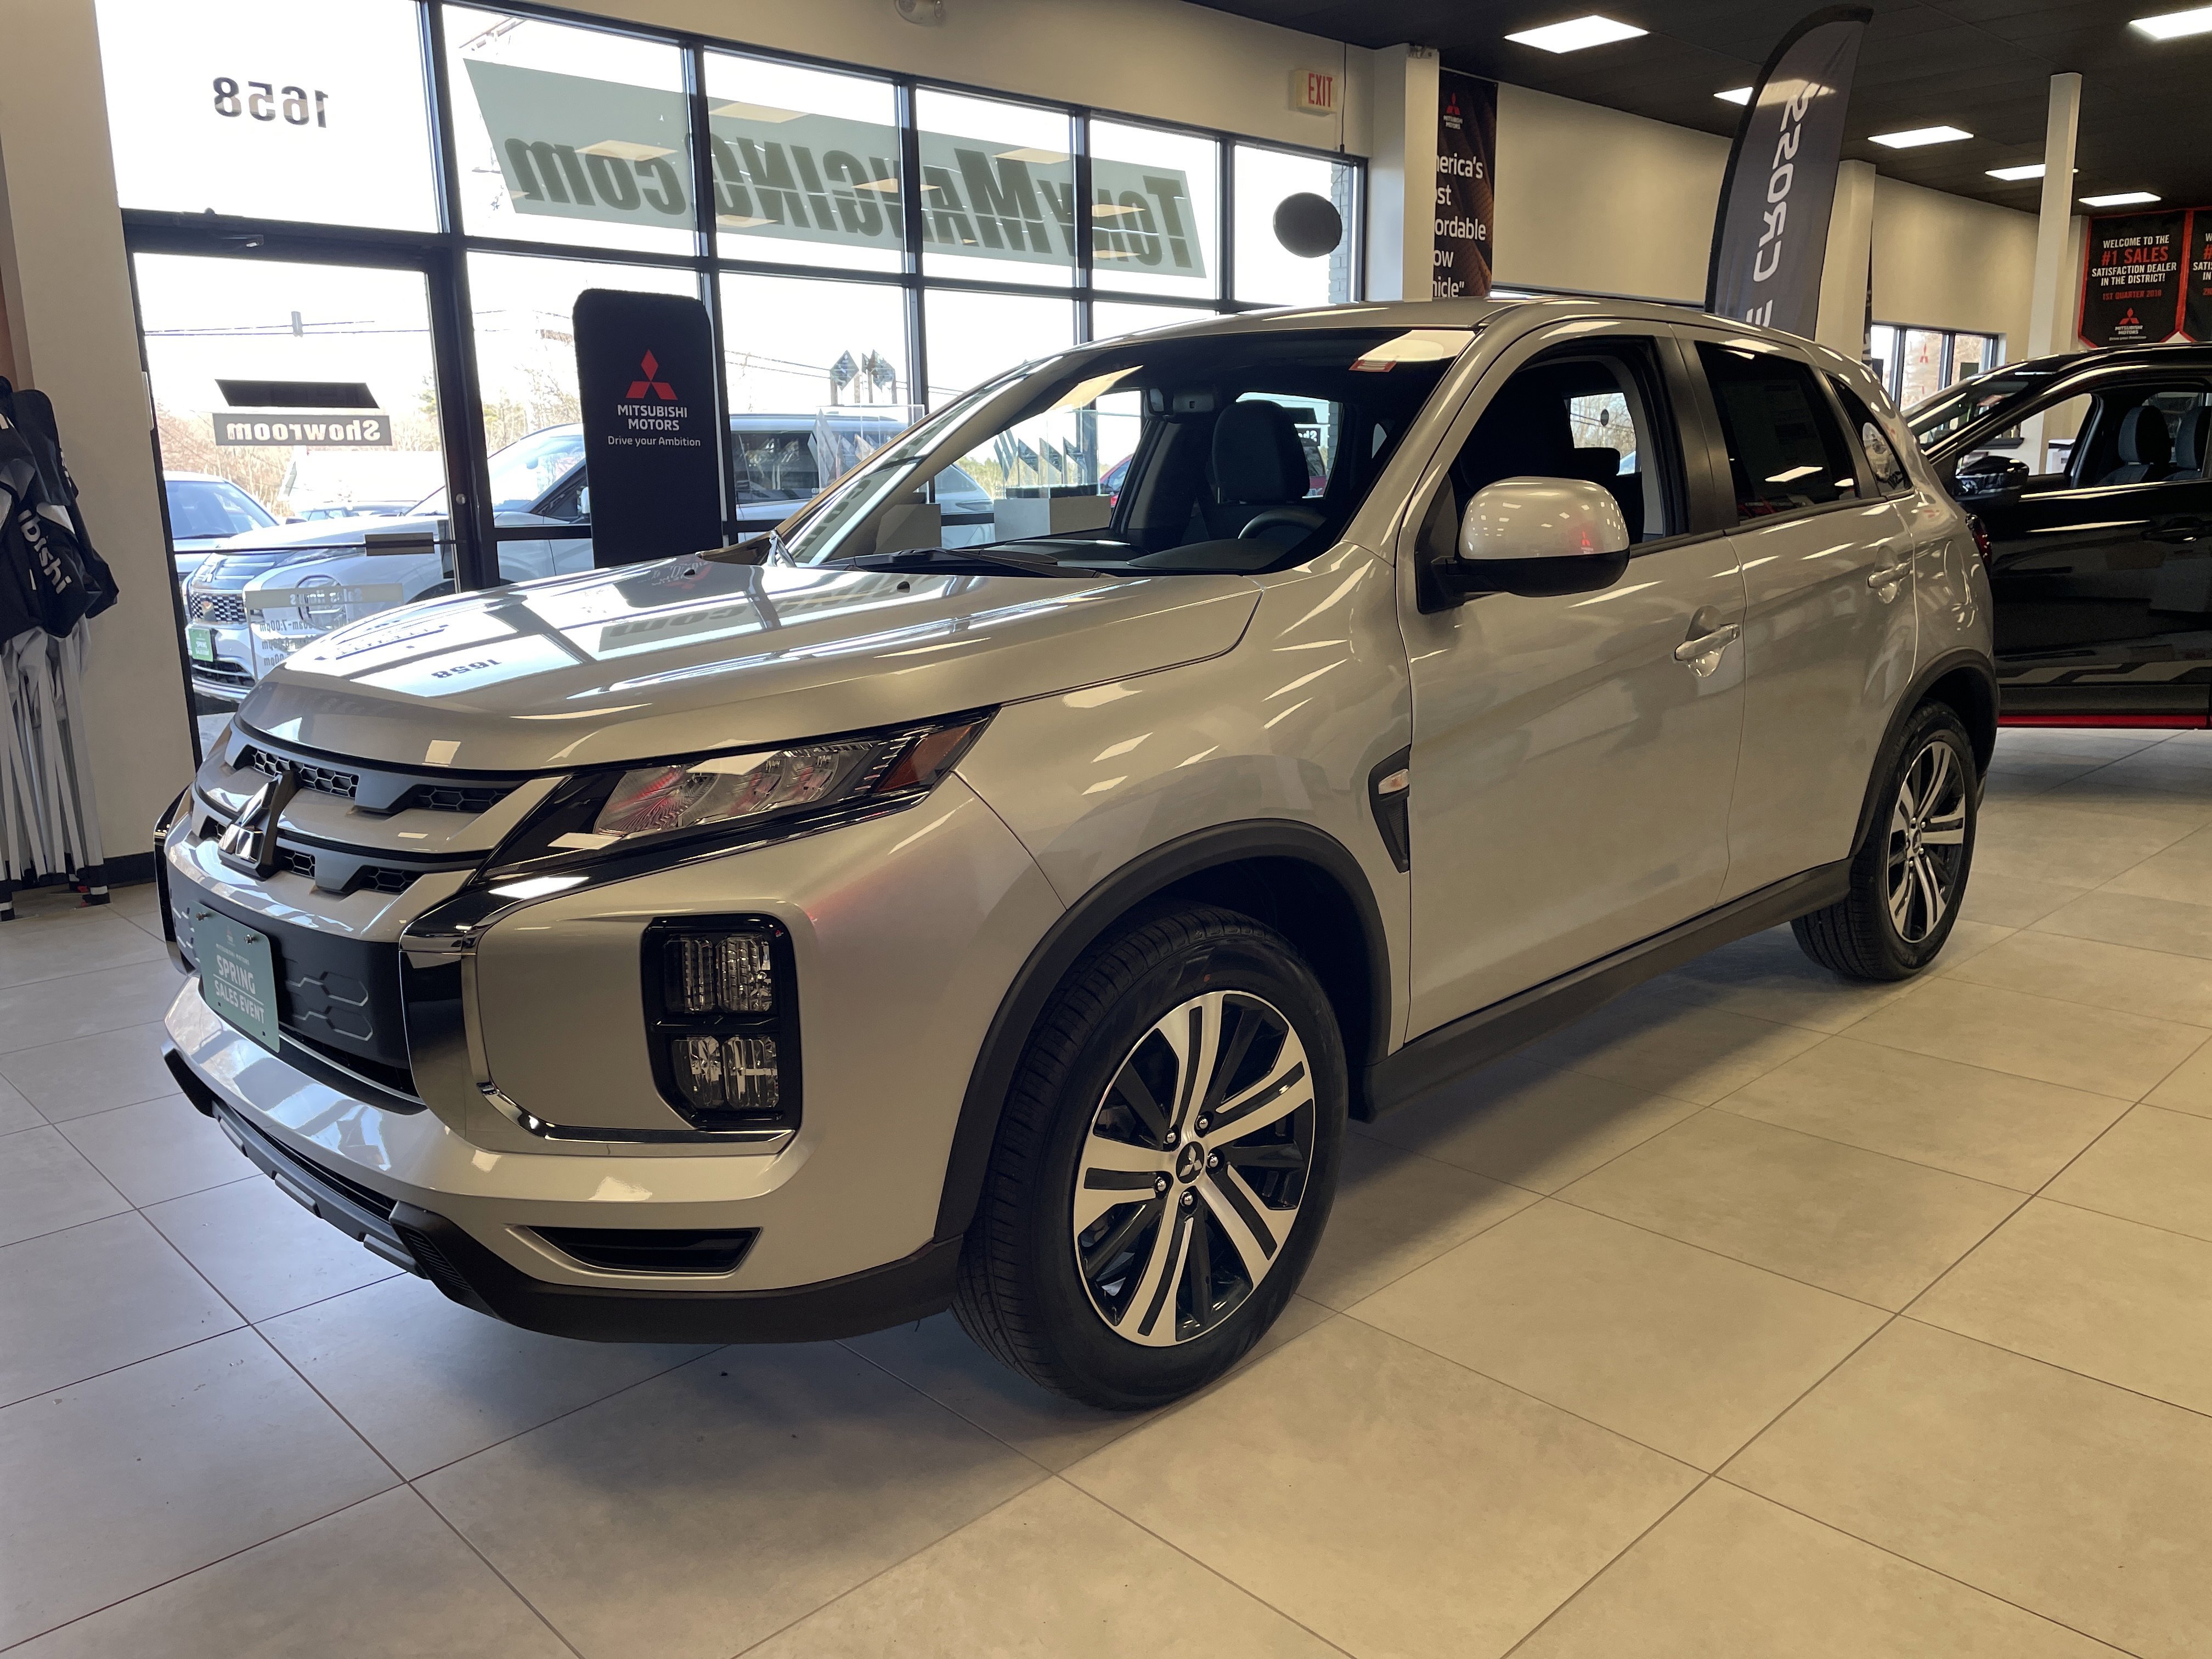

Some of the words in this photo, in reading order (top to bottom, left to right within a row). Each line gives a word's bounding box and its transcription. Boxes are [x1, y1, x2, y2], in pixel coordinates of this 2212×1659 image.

[1308, 72, 1333, 108] EXIT
[1437, 184, 1452, 206] st
[2103, 236, 2141, 249] WELCOME
[2143, 236, 2153, 245] TO
[2155, 234, 2170, 244] THE
[2101, 249, 2117, 266] #1
[2124, 246, 2169, 264] SALES
[2091, 264, 2145, 277] SATISFACTION
[2147, 262, 2177, 273] DEALER
[2101, 278, 2109, 286] IN
[2112, 275, 2125, 286] THE
[2128, 273, 2165, 284] DISTRICT!
[2115, 290, 2145, 300] QUARTER
[617, 404, 688, 418] MITSUBISHI
[628, 418, 680, 431] MOTORS
[607, 435, 633, 445] Drive
[635, 438, 657, 448] your
[658, 436, 701, 447] Ambition
[216, 953, 256, 995] SPRING
[213, 979, 239, 1008] SALES
[239, 994, 264, 1025] EVENT
